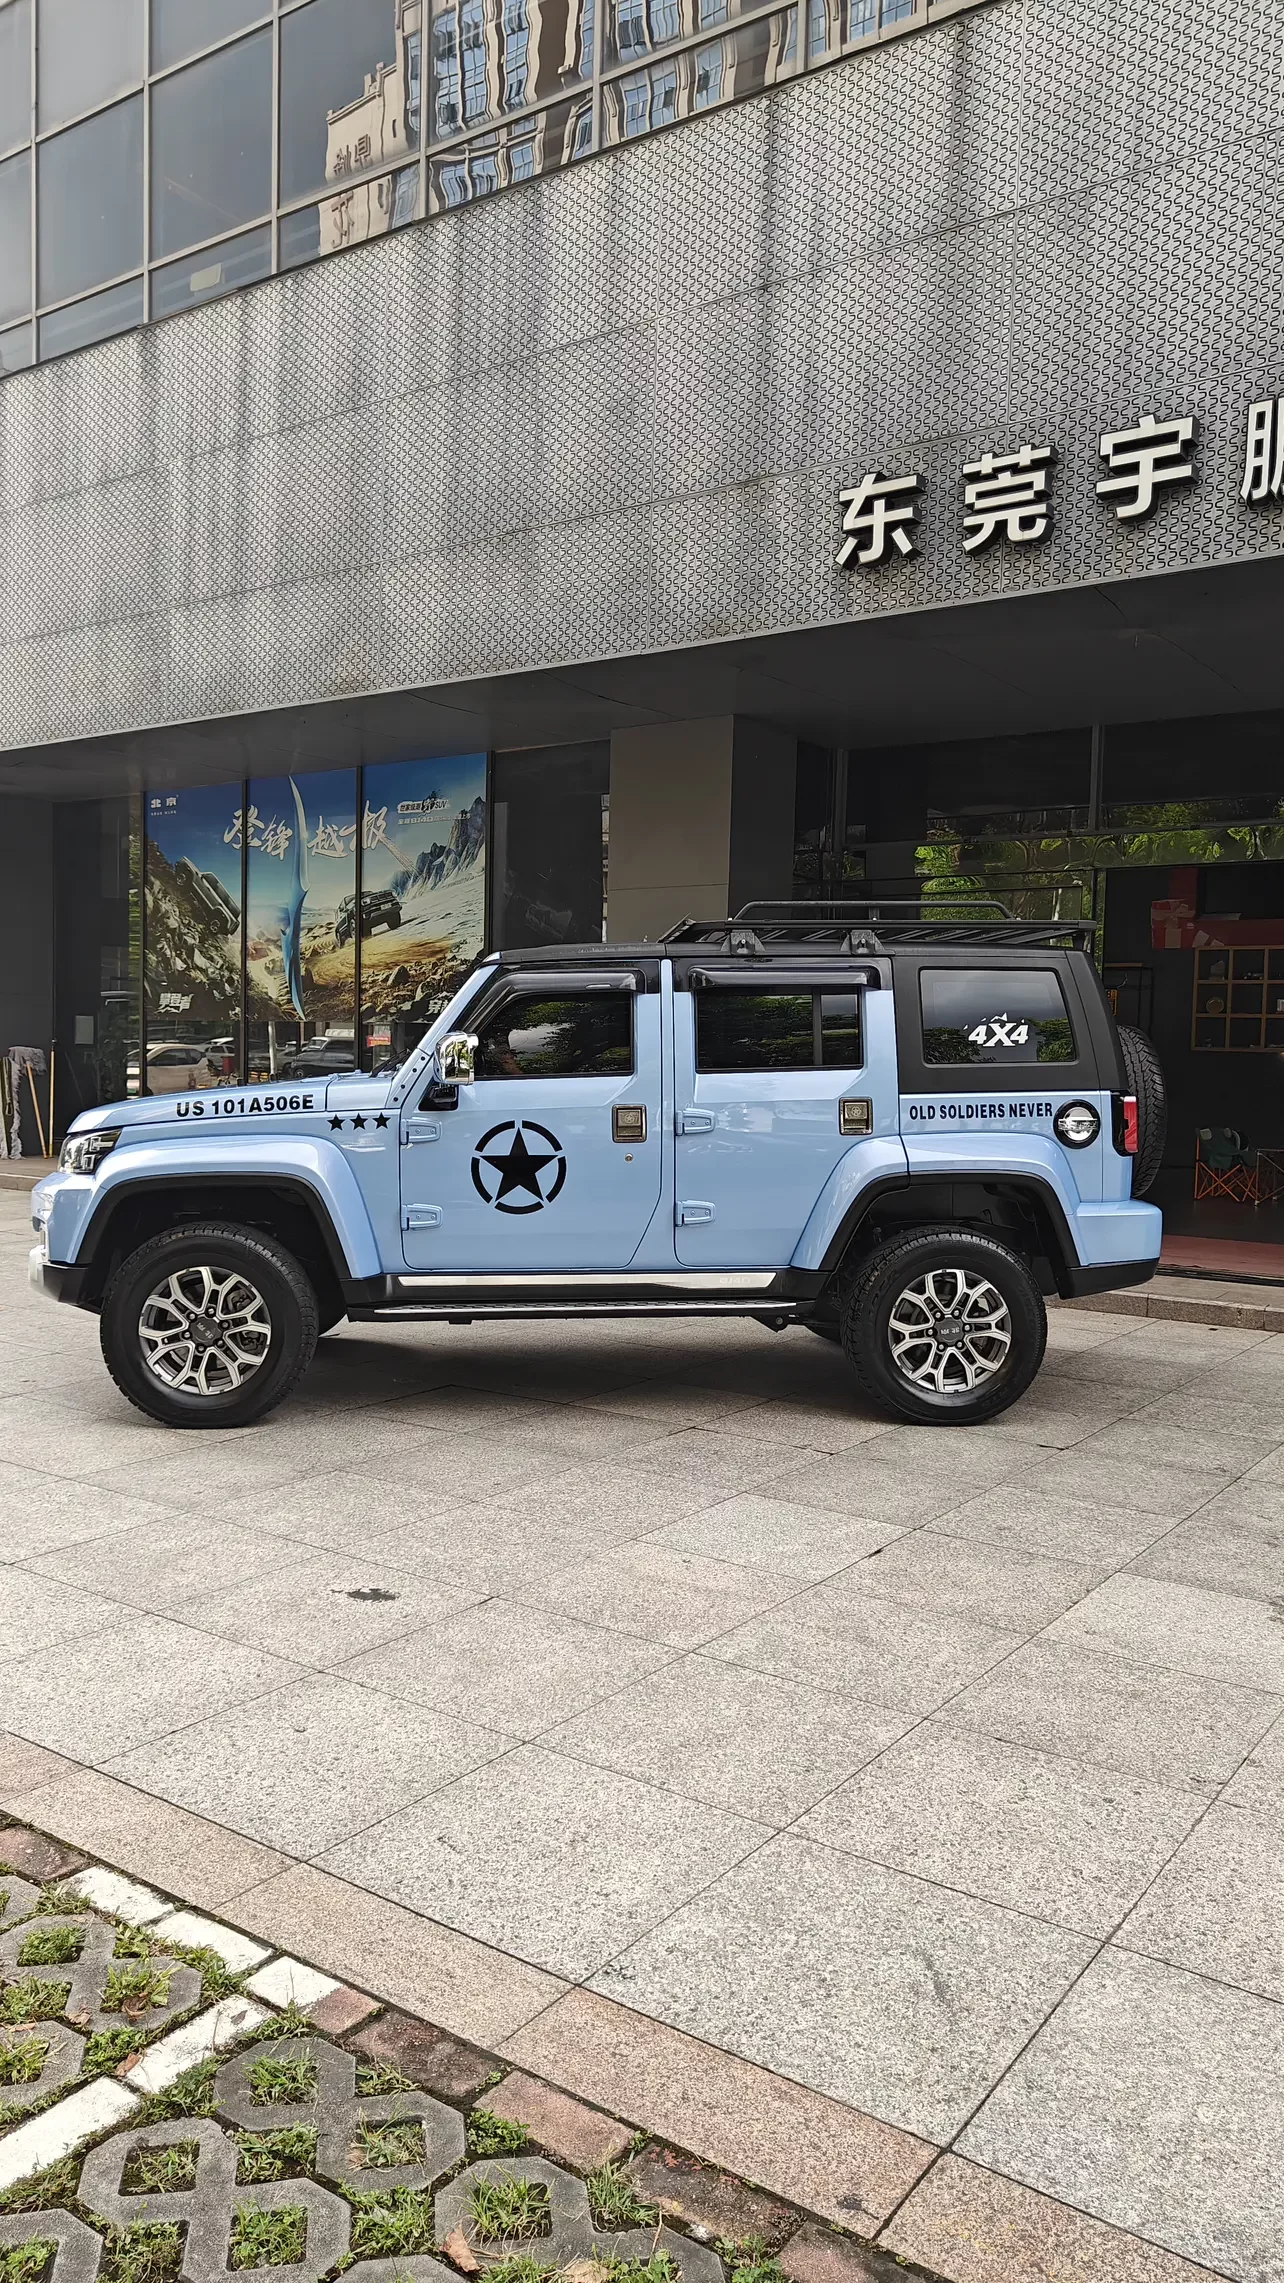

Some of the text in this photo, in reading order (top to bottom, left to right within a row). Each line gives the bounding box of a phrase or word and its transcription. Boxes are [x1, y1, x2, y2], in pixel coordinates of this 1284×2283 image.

[150, 796, 177, 809] 北京
[176, 1094, 314, 1118] US 101A506E
[909, 1102, 1053, 1121] OLD SOLDIERS NEVER
